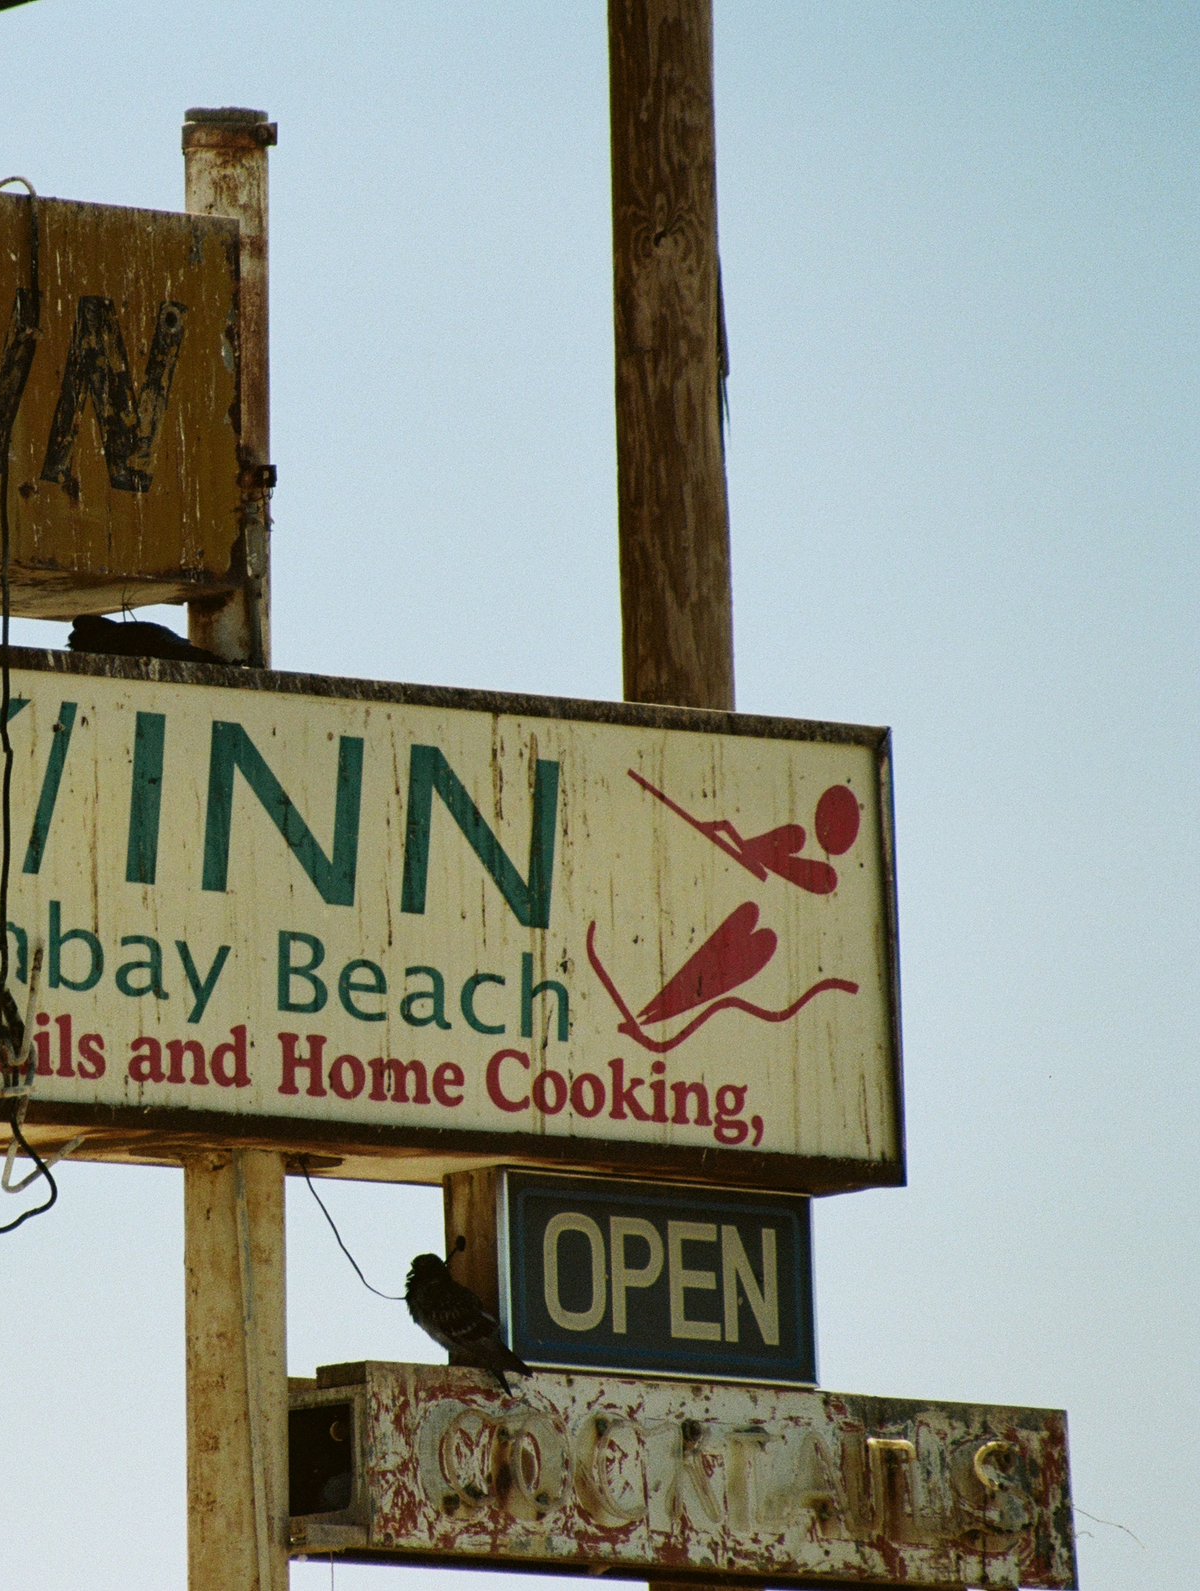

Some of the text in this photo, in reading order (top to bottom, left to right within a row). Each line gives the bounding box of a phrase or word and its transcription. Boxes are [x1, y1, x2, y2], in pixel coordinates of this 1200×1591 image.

[125, 711, 560, 928] INN
[276, 930, 571, 1042] Beach
[127, 1025, 253, 1088] and
[278, 1032, 466, 1108] Home
[485, 1048, 764, 1147] Cooking,
[542, 1212, 780, 1346] OPEN
